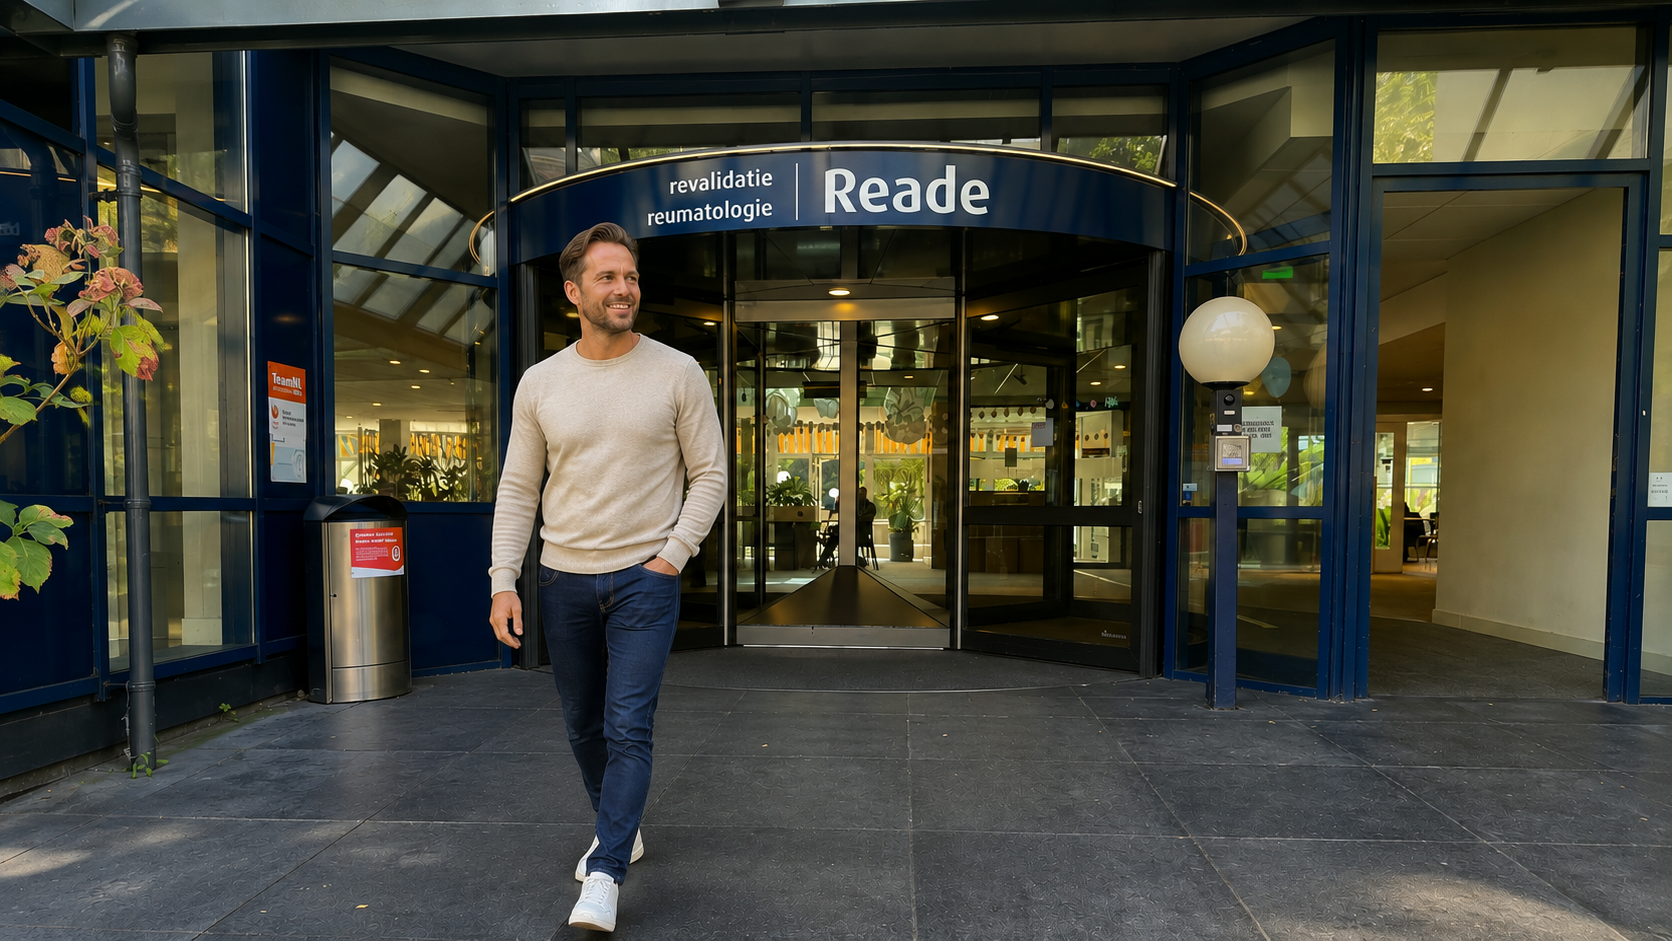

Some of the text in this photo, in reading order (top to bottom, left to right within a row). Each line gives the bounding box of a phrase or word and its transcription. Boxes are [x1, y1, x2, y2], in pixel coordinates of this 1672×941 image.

[669, 168, 773, 195] revalidatie
[824, 164, 990, 215] Reade
[647, 198, 773, 226] reumatologie
[271, 372, 303, 390] TeamNL
